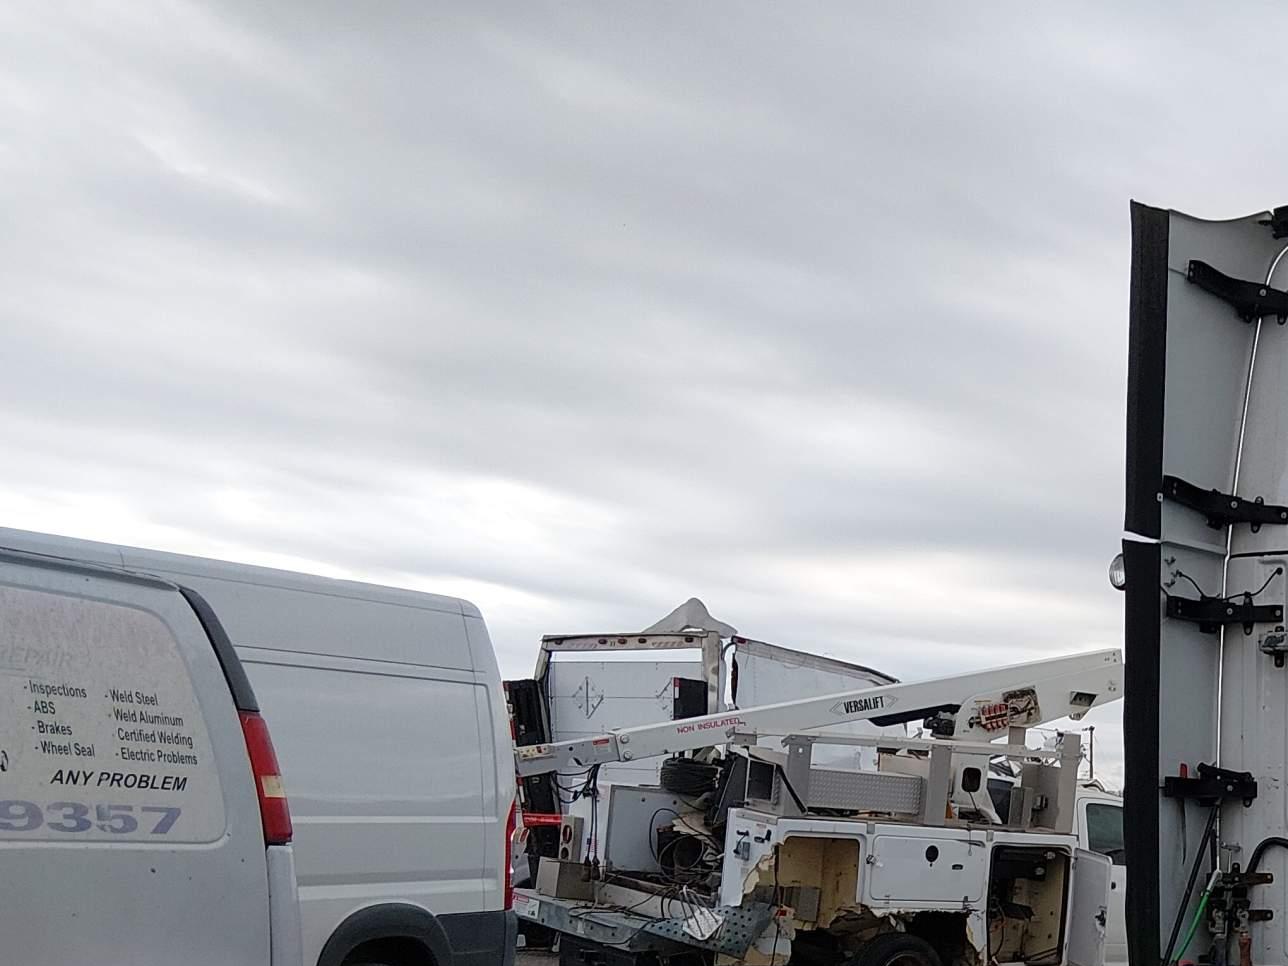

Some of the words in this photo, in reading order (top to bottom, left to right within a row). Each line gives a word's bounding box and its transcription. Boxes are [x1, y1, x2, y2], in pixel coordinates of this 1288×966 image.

[29, 680, 88, 699] Inspections
[110, 689, 134, 704] Weld
[135, 691, 159, 706] Steel
[33, 701, 56, 715] ABS
[842, 695, 885, 715] VERSALIFT
[113, 708, 137, 724] Weld
[139, 712, 184, 727] Aluminum
[676, 725, 695, 735] NON
[697, 717, 740, 732] INSULATED
[37, 721, 73, 736] Brakes
[117, 728, 157, 743] Certified
[158, 732, 193, 749] Welding
[40, 740, 72, 756] Wheel
[73, 744, 95, 758] Seal
[120, 748, 156, 763] Electric
[157, 750, 198, 766] Problems
[50, 769, 94, 786] ANY
[97, 771, 188, 792] PROBLEM
